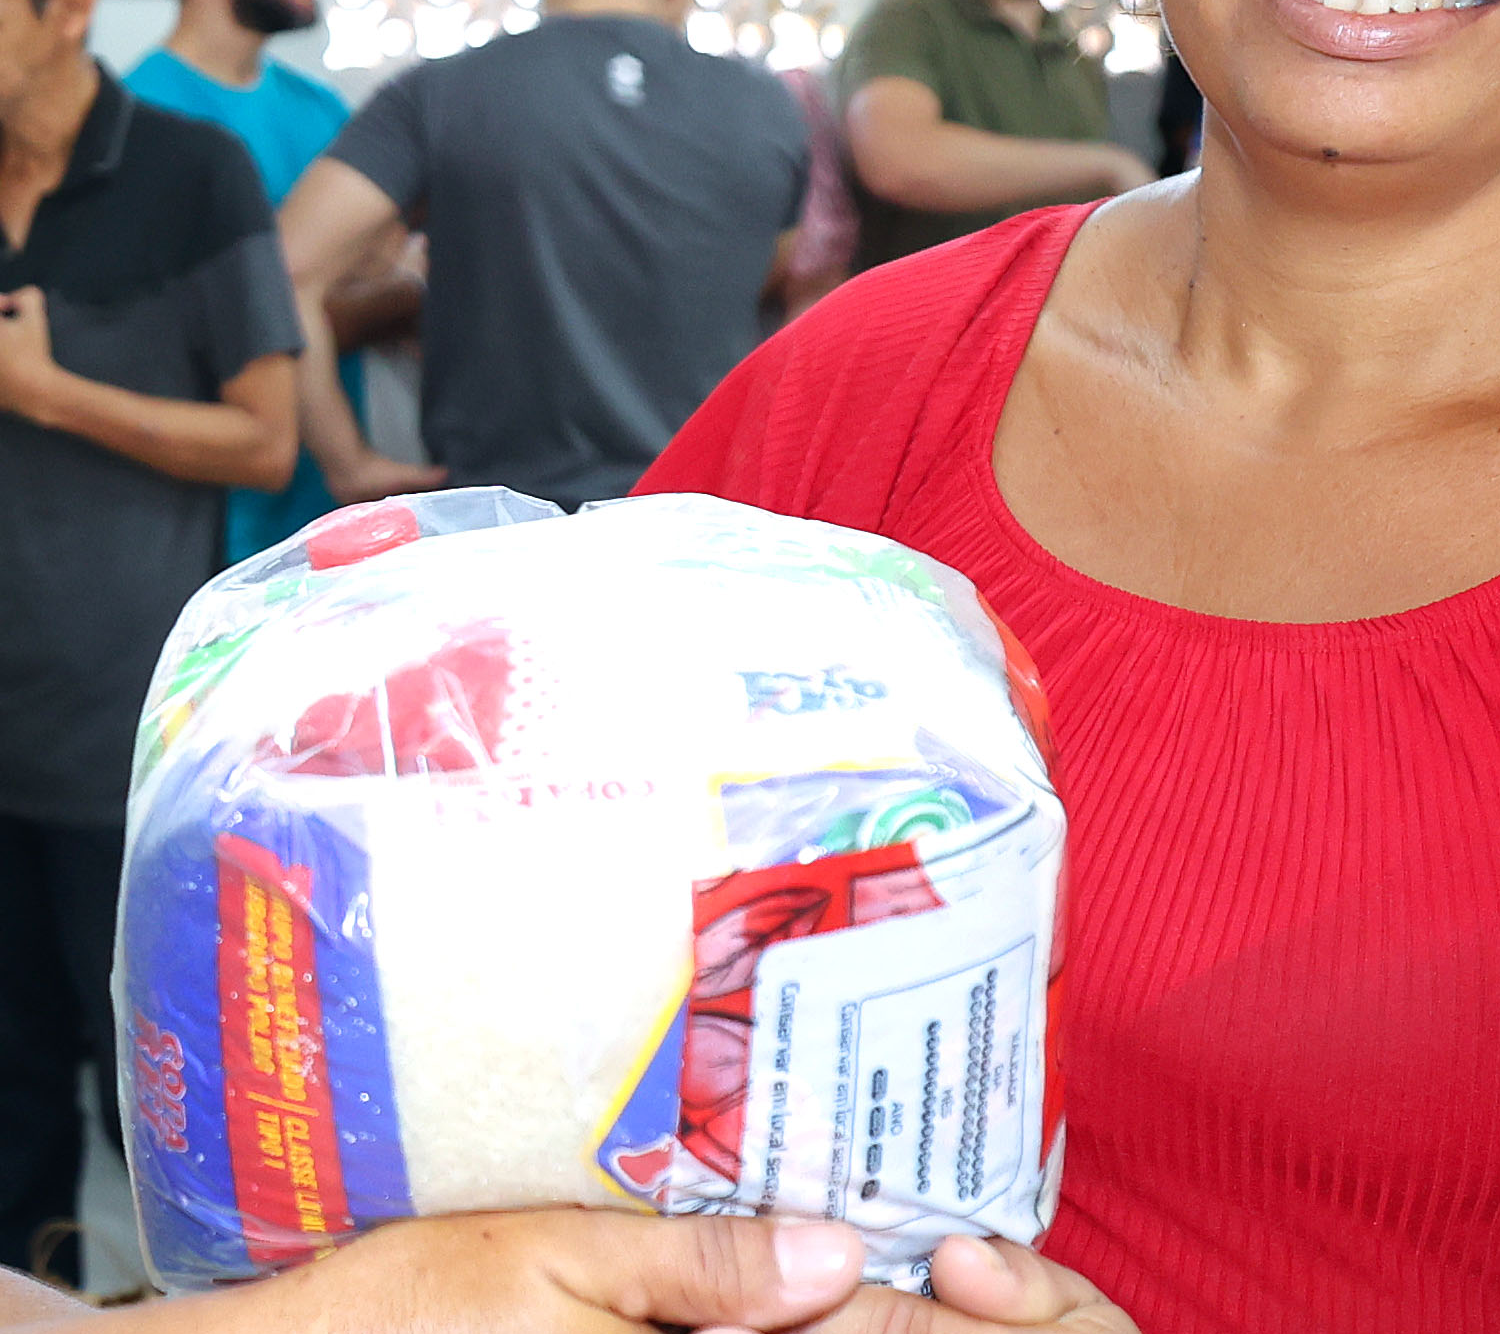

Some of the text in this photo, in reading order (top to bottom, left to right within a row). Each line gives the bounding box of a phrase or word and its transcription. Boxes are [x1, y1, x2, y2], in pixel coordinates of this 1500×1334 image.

[774, 980, 801, 1073] Conservar
[837, 1001, 858, 1078] Conservar
[158, 1030, 190, 1154] COPA
[771, 1080, 789, 1109] em
[768, 1112, 792, 1151] local
[832, 1109, 852, 1143] local
[890, 1101, 905, 1137] ANO
